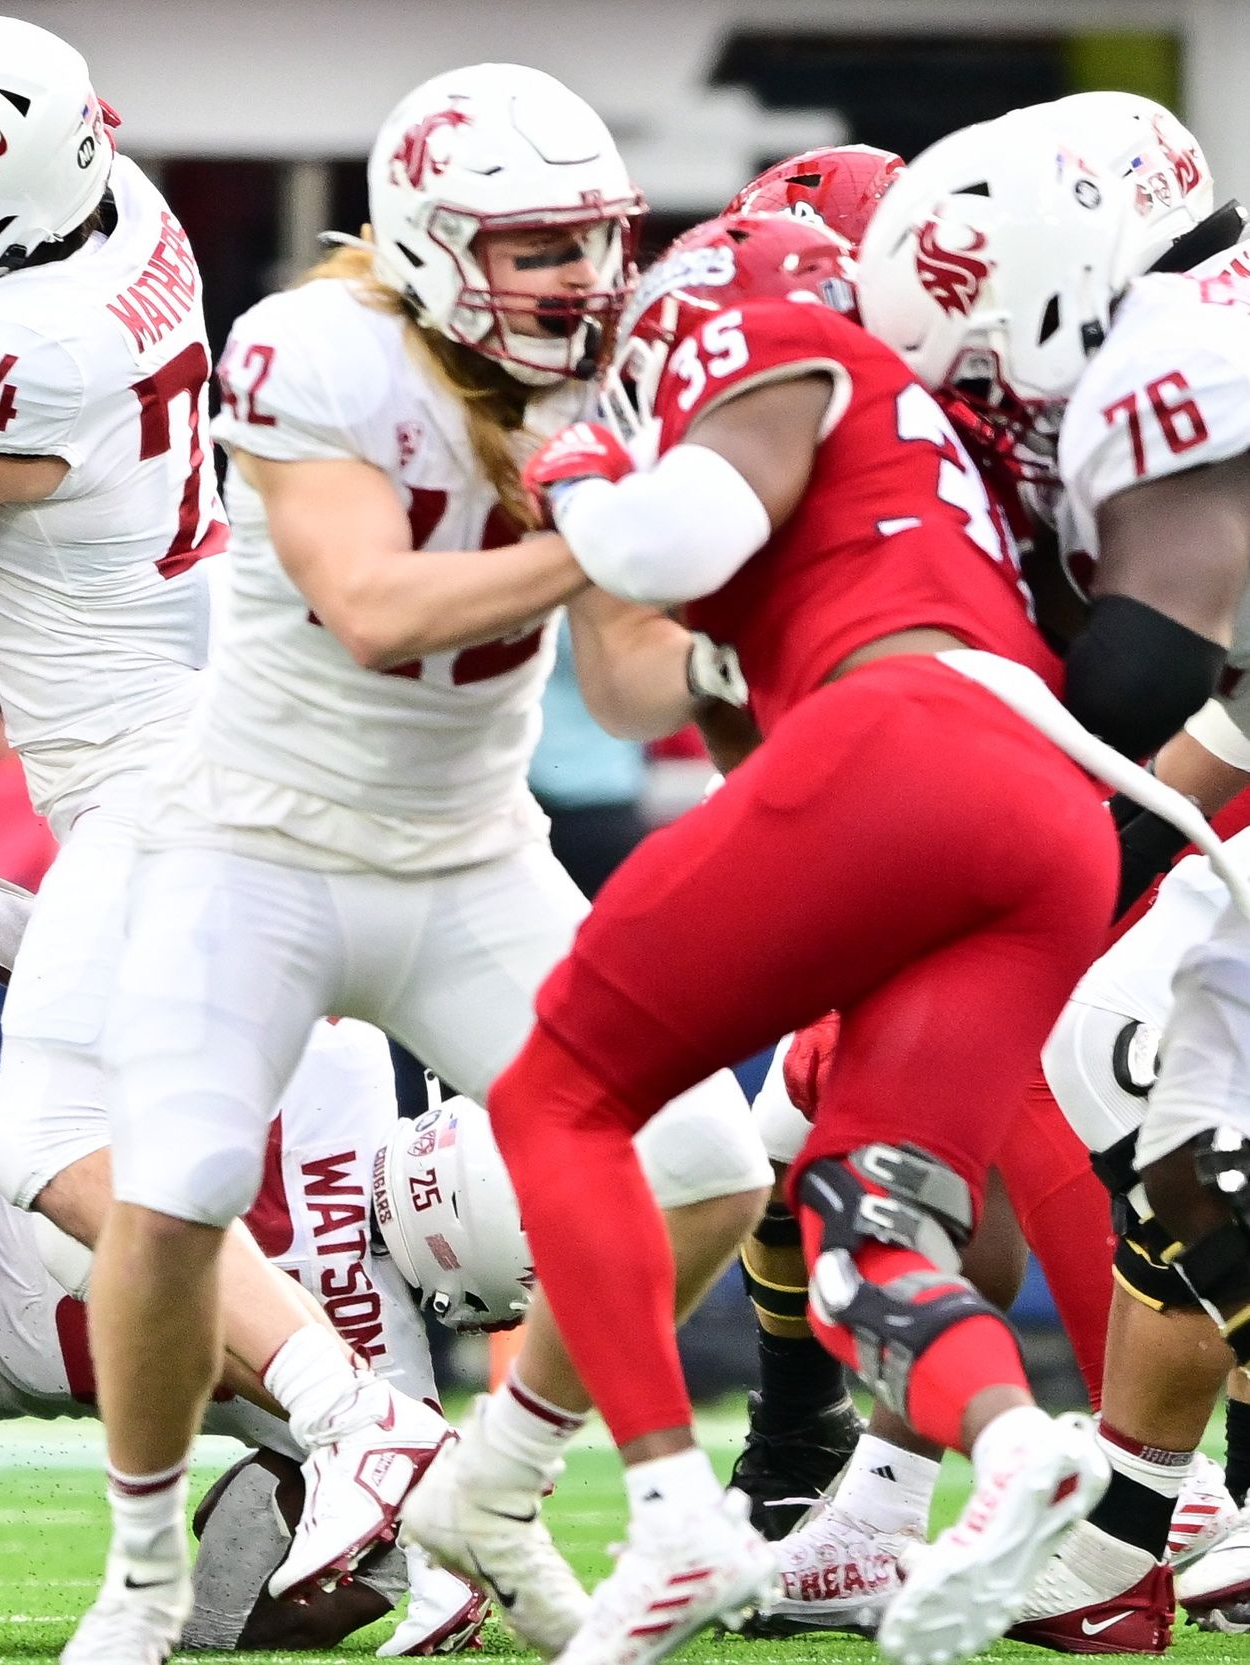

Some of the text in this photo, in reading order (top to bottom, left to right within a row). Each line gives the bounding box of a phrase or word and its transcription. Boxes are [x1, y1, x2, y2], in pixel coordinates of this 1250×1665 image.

[669, 310, 750, 411] 35
[1101, 369, 1209, 477] 76
[373, 1146, 393, 1225] COUGARS
[409, 1167, 442, 1212] 25
[301, 1150, 387, 1363] WATSON
